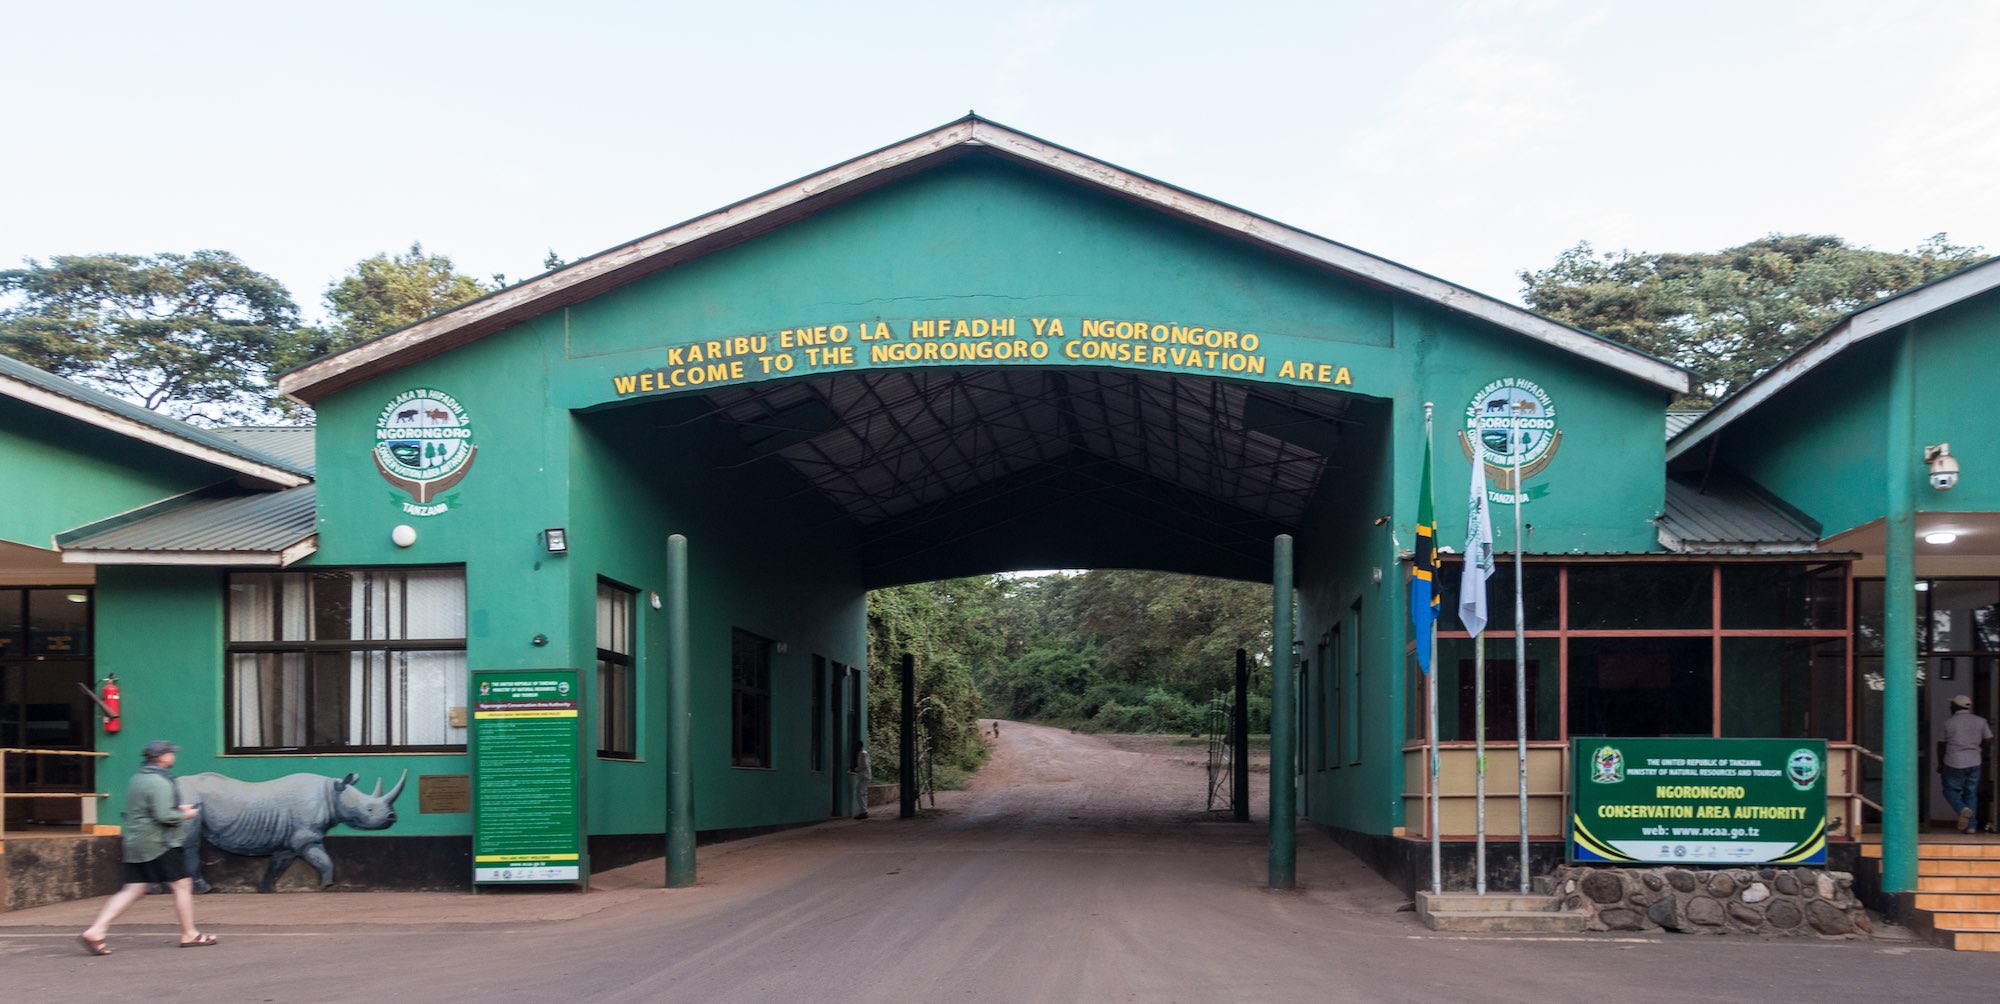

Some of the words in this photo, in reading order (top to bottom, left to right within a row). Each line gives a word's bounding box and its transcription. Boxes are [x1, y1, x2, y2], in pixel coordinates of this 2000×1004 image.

[668, 336, 767, 366] KARIBU
[780, 325, 848, 348] ENEO
[860, 322, 891, 341] LA
[912, 318, 1015, 339] HIFADHI
[1032, 318, 1064, 337] YA
[1082, 320, 1259, 352] NGORONGORO
[614, 361, 744, 395] WELCOME
[759, 353, 794, 374] TO
[806, 347, 854, 366] THE
[871, 340, 1048, 363] NGORONGORO
[1065, 340, 1265, 374] CONSERVATION
[1279, 360, 1352, 386] AREA
[1466, 380, 1504, 417] MAMLAKA
[1503, 378, 1514, 386] YA
[1516, 378, 1552, 406] HIFADHI
[1545, 405, 1556, 418] YA
[376, 390, 416, 428] MAMLAKA
[416, 388, 428, 398] YA
[428, 389, 464, 414] HIFADHI
[459, 413, 470, 426] YA
[376, 428, 472, 439] NGORONGORO
[1488, 490, 1530, 504] TANZAIA
[402, 502, 448, 516] TANZANIA
[1656, 786, 1745, 799] NGORONGORO
[1598, 805, 1693, 818] CONSERVATION
[1696, 806, 1730, 819] AREA
[1734, 806, 1806, 819] AUTHORITY
[1642, 825, 1669, 835] web:
[1672, 826, 1760, 839] www.ncaa.go.tz
